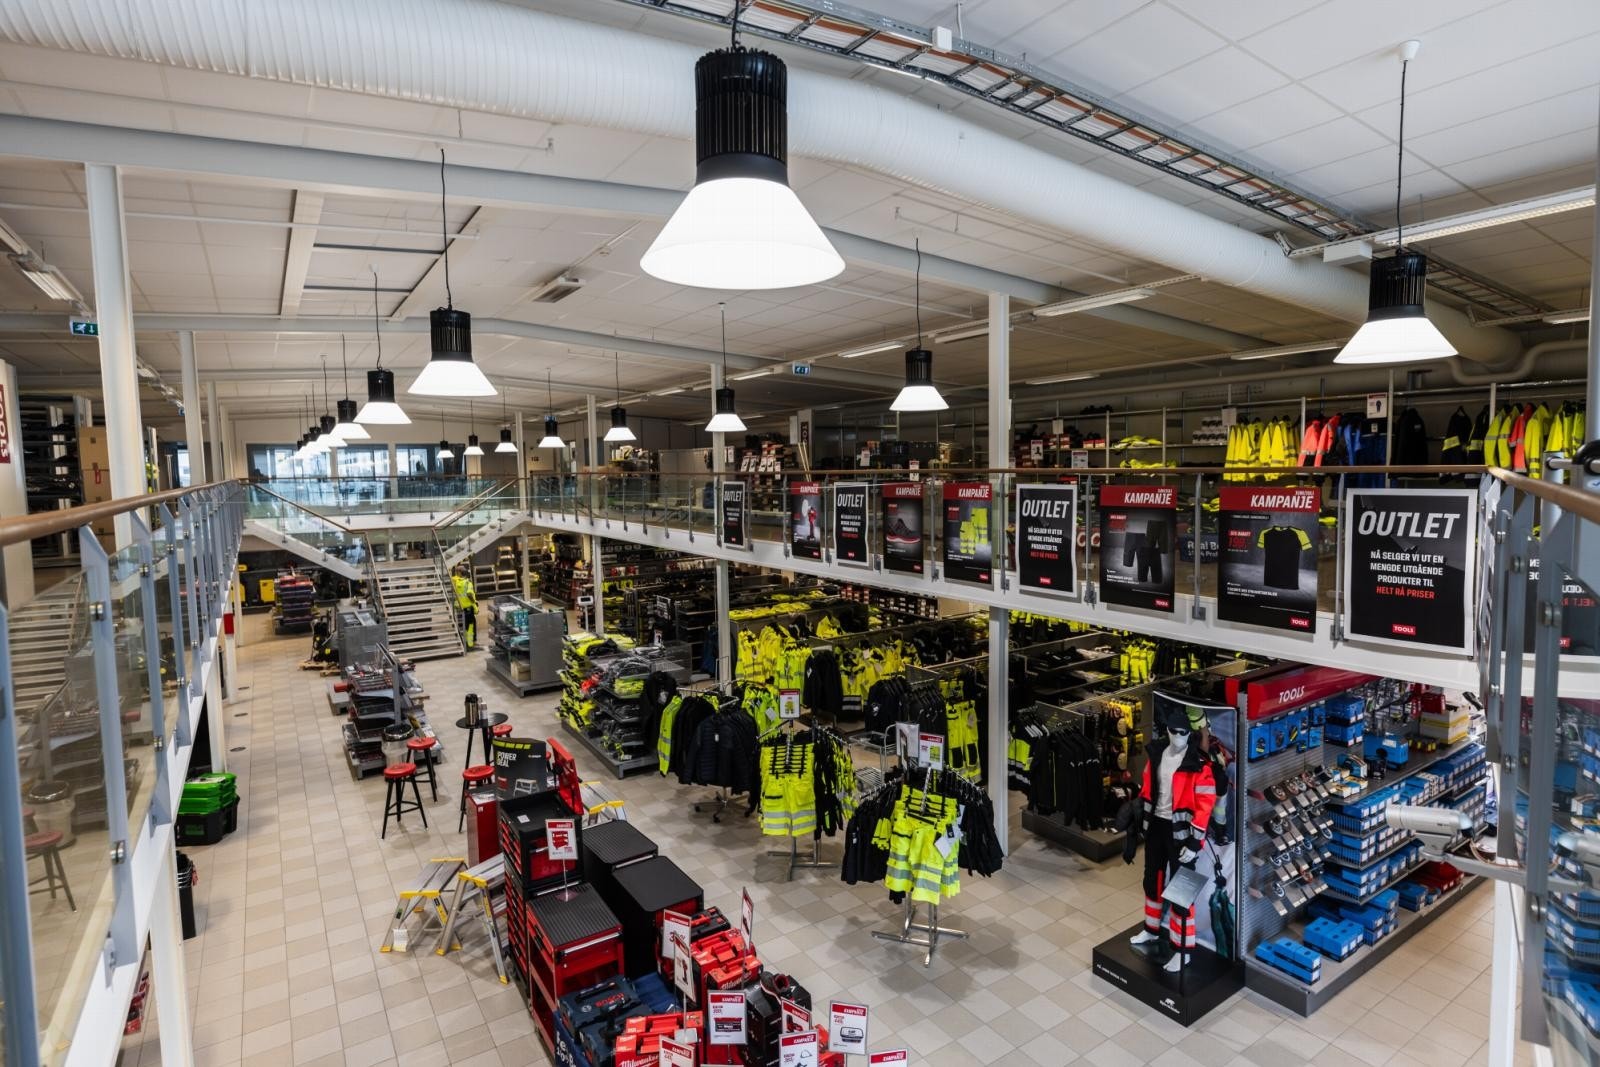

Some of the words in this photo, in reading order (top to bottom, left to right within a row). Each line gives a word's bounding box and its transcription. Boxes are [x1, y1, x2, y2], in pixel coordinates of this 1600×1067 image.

[0, 391, 8, 458] OOLS
[958, 488, 990, 498] KAMPANJE
[1124, 492, 1172, 505] KAMPANJE
[837, 493, 865, 508] OUTLET
[1250, 494, 1314, 509] KAMPANJE
[1021, 499, 1070, 519] OUTLET
[1357, 510, 1461, 539] OUTLET
[1370, 549, 1381, 559] NÅ
[1382, 551, 1411, 561] SELGER
[1412, 553, 1420, 562] VI
[1421, 554, 1432, 563] UT
[1433, 555, 1444, 564] EN
[1370, 562, 1401, 573] MENGDE
[1403, 563, 1444, 576] UTGÅENDE
[1377, 574, 1421, 586] PRODUKTER
[1423, 578, 1434, 587] TIL
[1376, 586, 1394, 595] HELT
[1396, 586, 1405, 596] RÅ
[1407, 589, 1435, 599] PRISER
[1394, 625, 1414, 633] TOOLS
[1279, 685, 1305, 704] TOOLS
[497, 751, 517, 761] POWER
